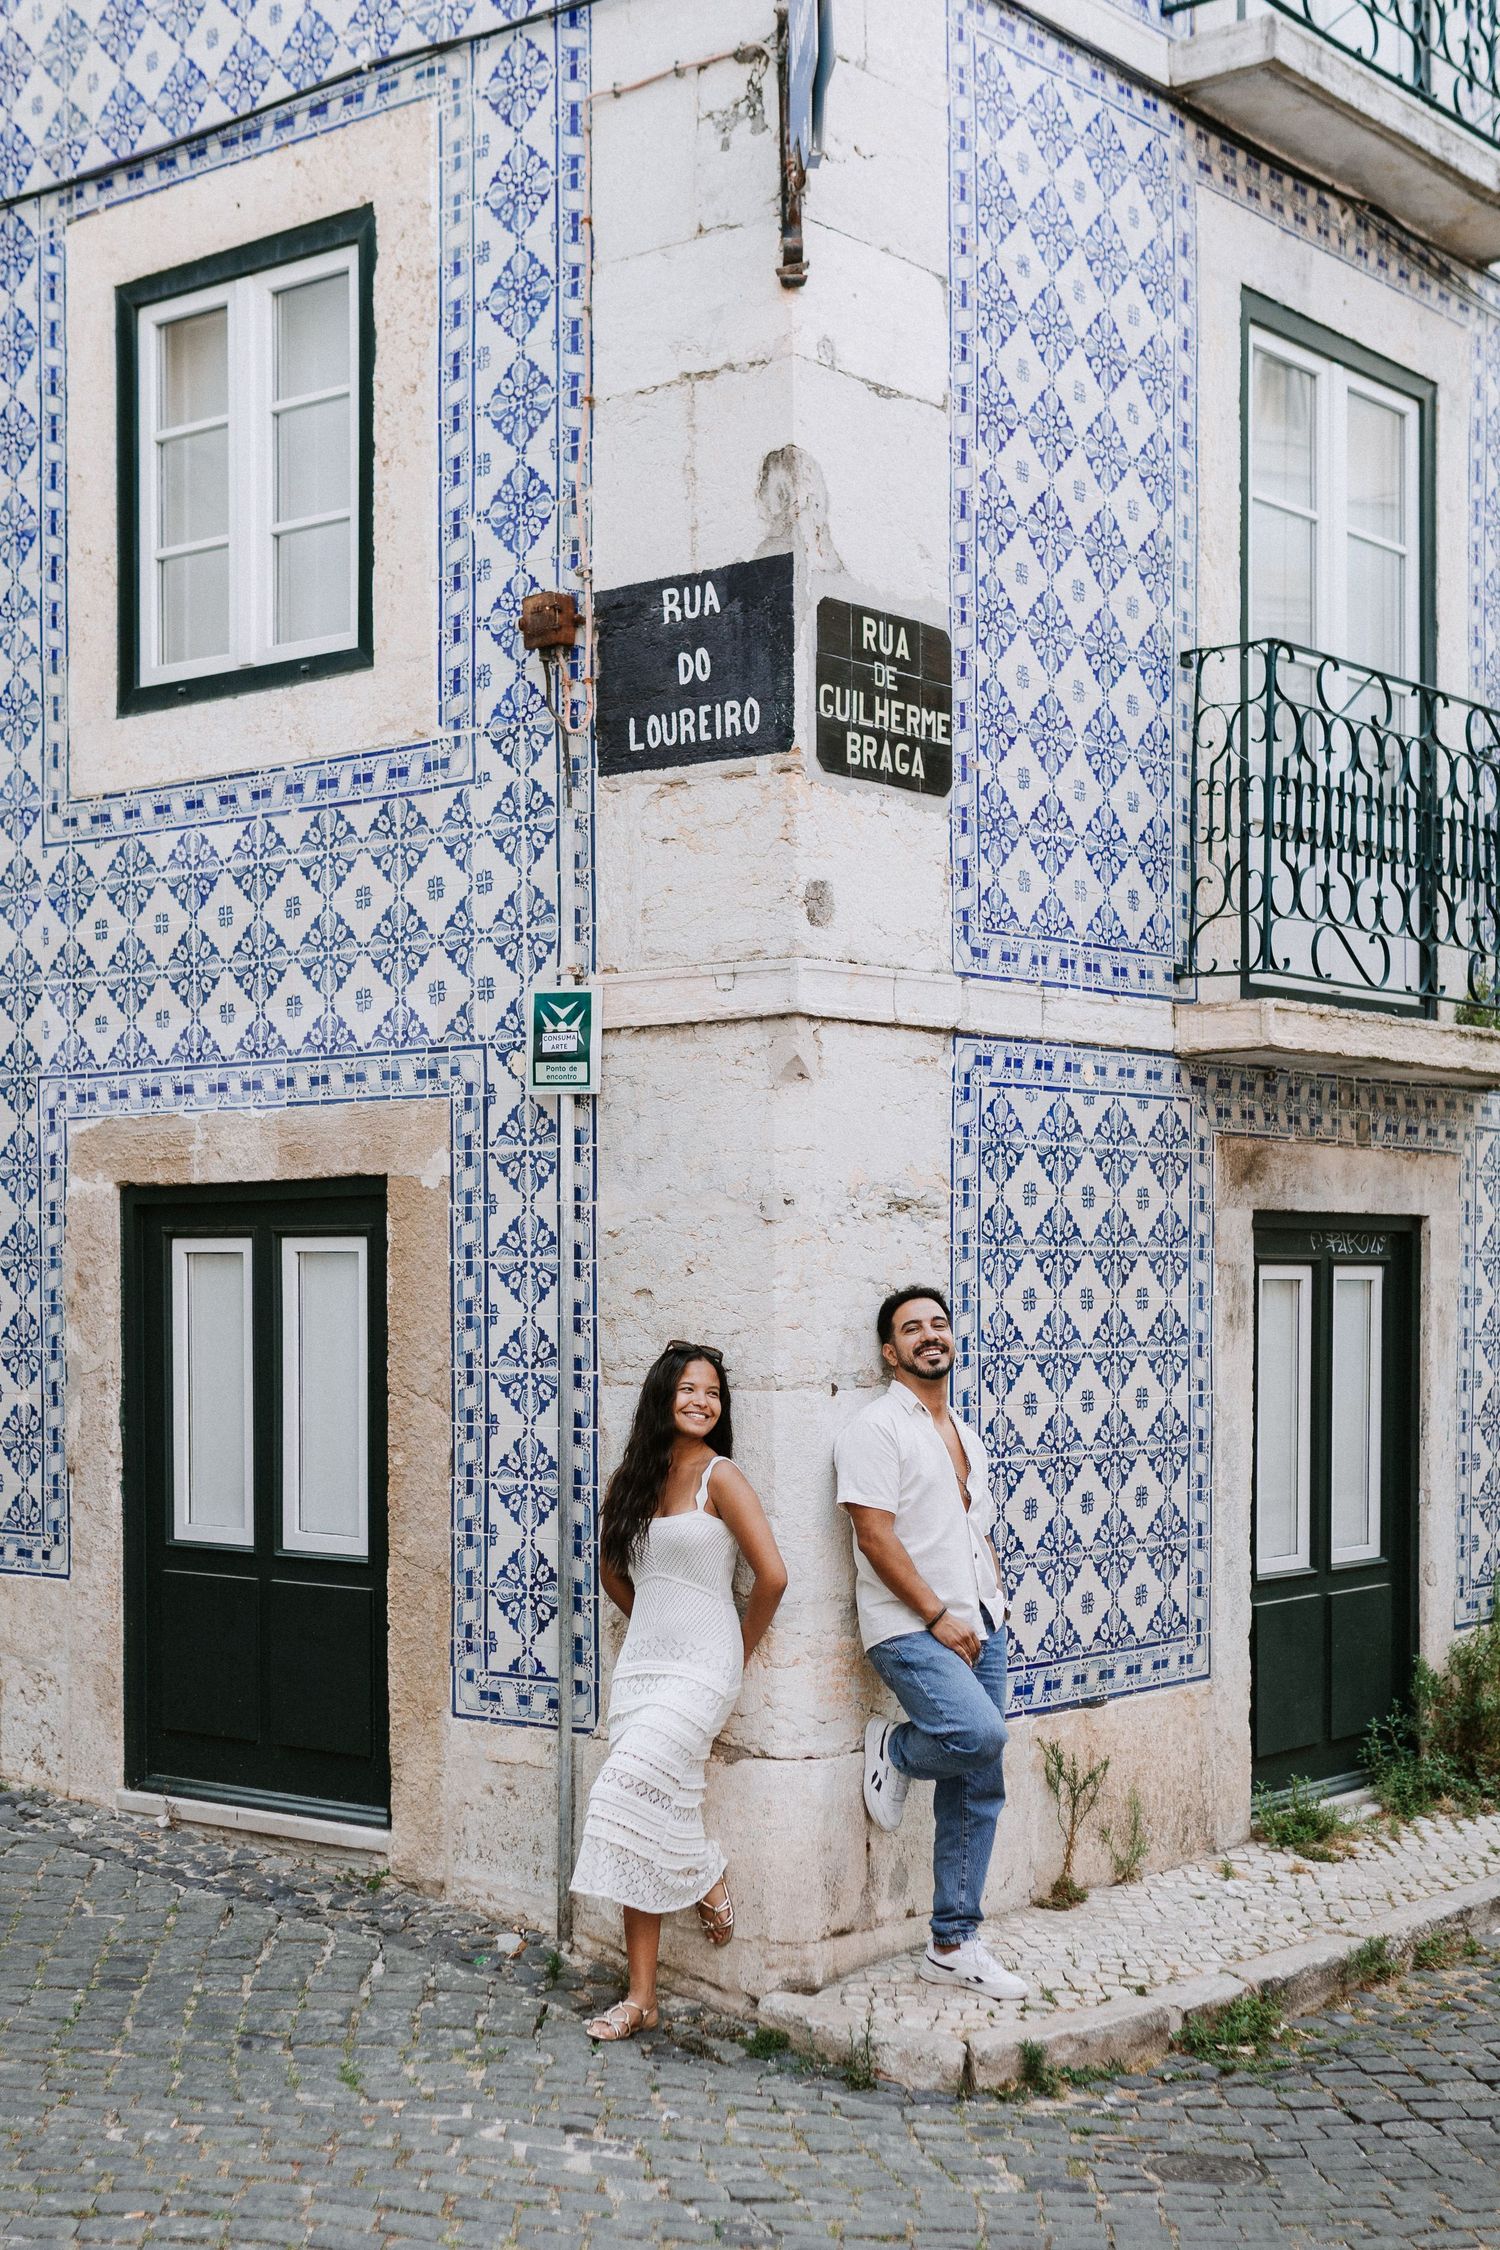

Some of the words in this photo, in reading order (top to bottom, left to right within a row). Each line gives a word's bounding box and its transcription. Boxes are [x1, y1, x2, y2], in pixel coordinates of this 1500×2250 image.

[662, 580, 721, 625] RUA
[862, 616, 911, 661] RUA
[677, 647, 711, 685] DO
[874, 661, 898, 692] DE
[628, 697, 760, 751] LOUREIRO
[819, 684, 952, 745] GUILHERME
[846, 732, 925, 779] BRAGA
[543, 1034, 576, 1042] CONSUMA
